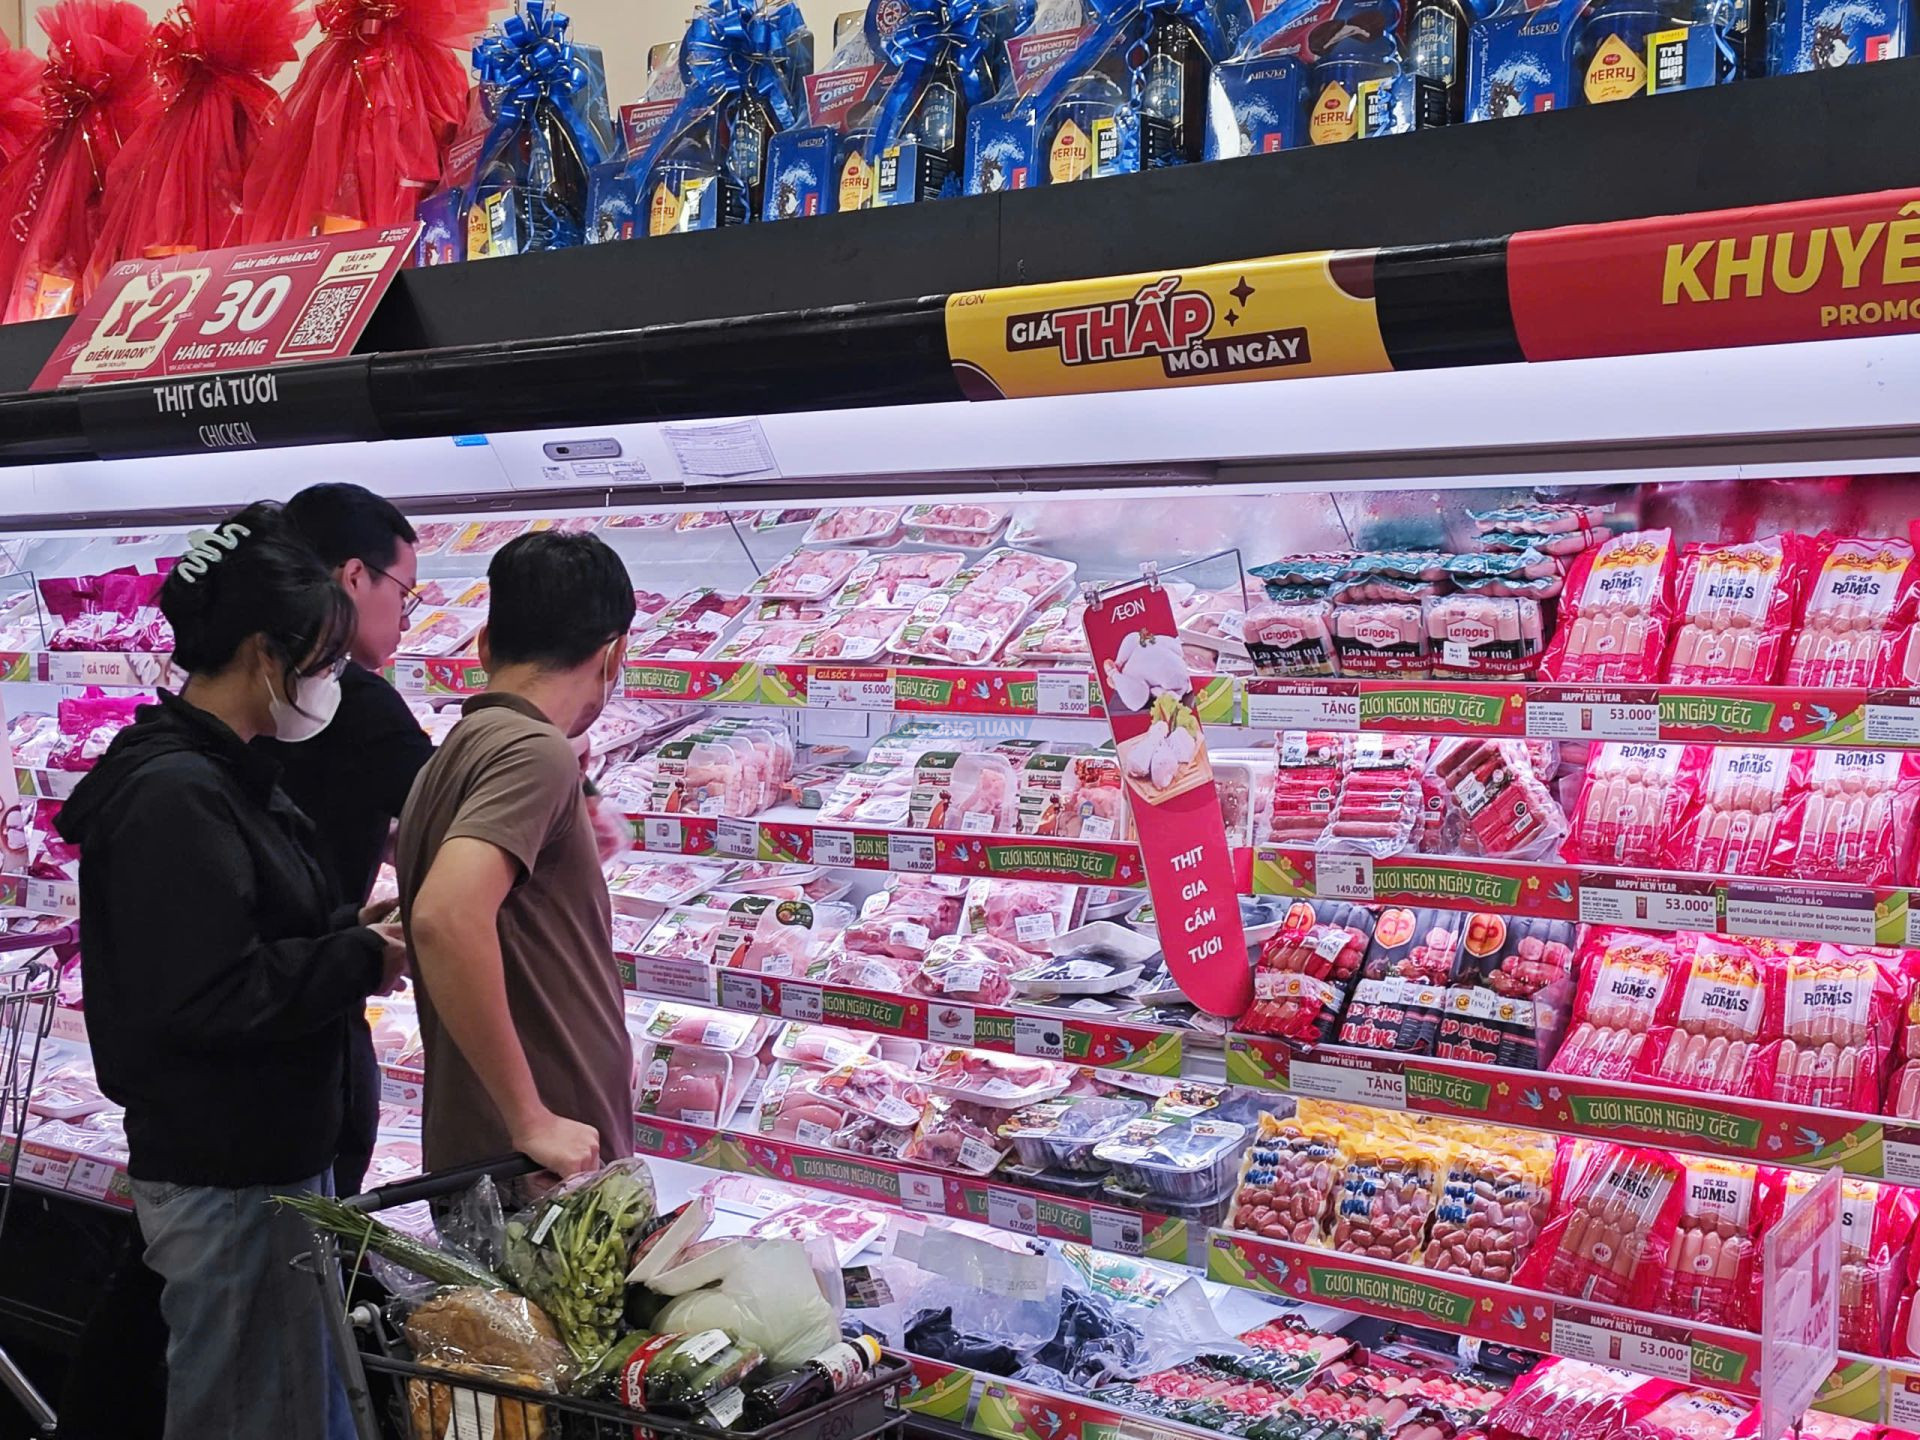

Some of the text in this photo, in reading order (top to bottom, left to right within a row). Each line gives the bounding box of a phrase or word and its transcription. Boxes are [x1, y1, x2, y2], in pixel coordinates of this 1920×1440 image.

[1590, 66, 1636, 84] MERRY
[820, 84, 856, 104] OREO
[635, 116, 668, 133] OREO
[1313, 113, 1353, 126] MERRY
[1053, 147, 1087, 161] MERRY
[231, 257, 257, 271] NGÀY
[357, 252, 377, 262] APP
[198, 274, 293, 336] 30
[1011, 277, 1212, 365] GIÁ THẤP
[85, 345, 112, 363] ĐIỂM
[172, 336, 269, 361] HÀNG THÁNG
[1168, 330, 1300, 373] MỖI NGÀY
[153, 373, 279, 419] THỊT GÀ TƯƠI
[199, 421, 257, 448] CHICKEN
[1832, 582, 1881, 596] ROMAS
[87, 662, 121, 676] GÀ TƯƠI
[830, 669, 848, 679] SỐC
[663, 670, 681, 689] TẾT
[919, 681, 940, 700] TẾT
[1278, 685, 1328, 695] HAPPY NEW YEAR
[1561, 692, 1621, 703] HAPPY NEW YEAR
[1321, 699, 1356, 717] TẶNG
[1386, 697, 1420, 714] NGON
[1422, 693, 1455, 716] NGÀY
[1458, 696, 1486, 719] TẾT
[1678, 698, 1752, 726] NGÀY TẾT
[1619, 744, 1667, 760] ROMAS
[1834, 751, 1885, 767] ROMAS
[1727, 760, 1773, 774] ROMAS
[1000, 847, 1103, 873] TƯƠI NGON NGÀY TẾT
[1170, 845, 1204, 872] THỊT
[1181, 879, 1209, 901] GIA
[1402, 873, 1436, 891] NGON
[1438, 871, 1472, 894] NGÀY
[1475, 874, 1503, 898] TẾT
[1615, 879, 1677, 893] HAPPY NEW YEAR
[1775, 894, 1823, 906] THÔNG BÁO
[1184, 907, 1217, 933] CẦM
[1188, 936, 1223, 965] TƯƠI
[1611, 980, 1656, 999] ROMAS
[1803, 991, 1853, 1006] ROMAS
[846, 997, 892, 1022] NGÀY TẾT
[1701, 992, 1749, 1012] ROMAS
[1320, 1055, 1373, 1070] HAPPY NEW YEAR
[1366, 1074, 1402, 1093] TẶNG
[1408, 1072, 1473, 1102] NGÀY TẾT
[1588, 1101, 1740, 1141] TƯƠI NGON NGÀY TẾT
[803, 1159, 897, 1192] TƯƠI NGON NGÀY TẾT
[1692, 1185, 1738, 1204] ROMAS
[1060, 1209, 1082, 1230] TẾT
[1323, 1273, 1456, 1317] TƯƠI NGON NGÀY TẾT
[1590, 1315, 1653, 1336] HAPPY NEW YEAR
[1692, 1344, 1724, 1374] TẾT
